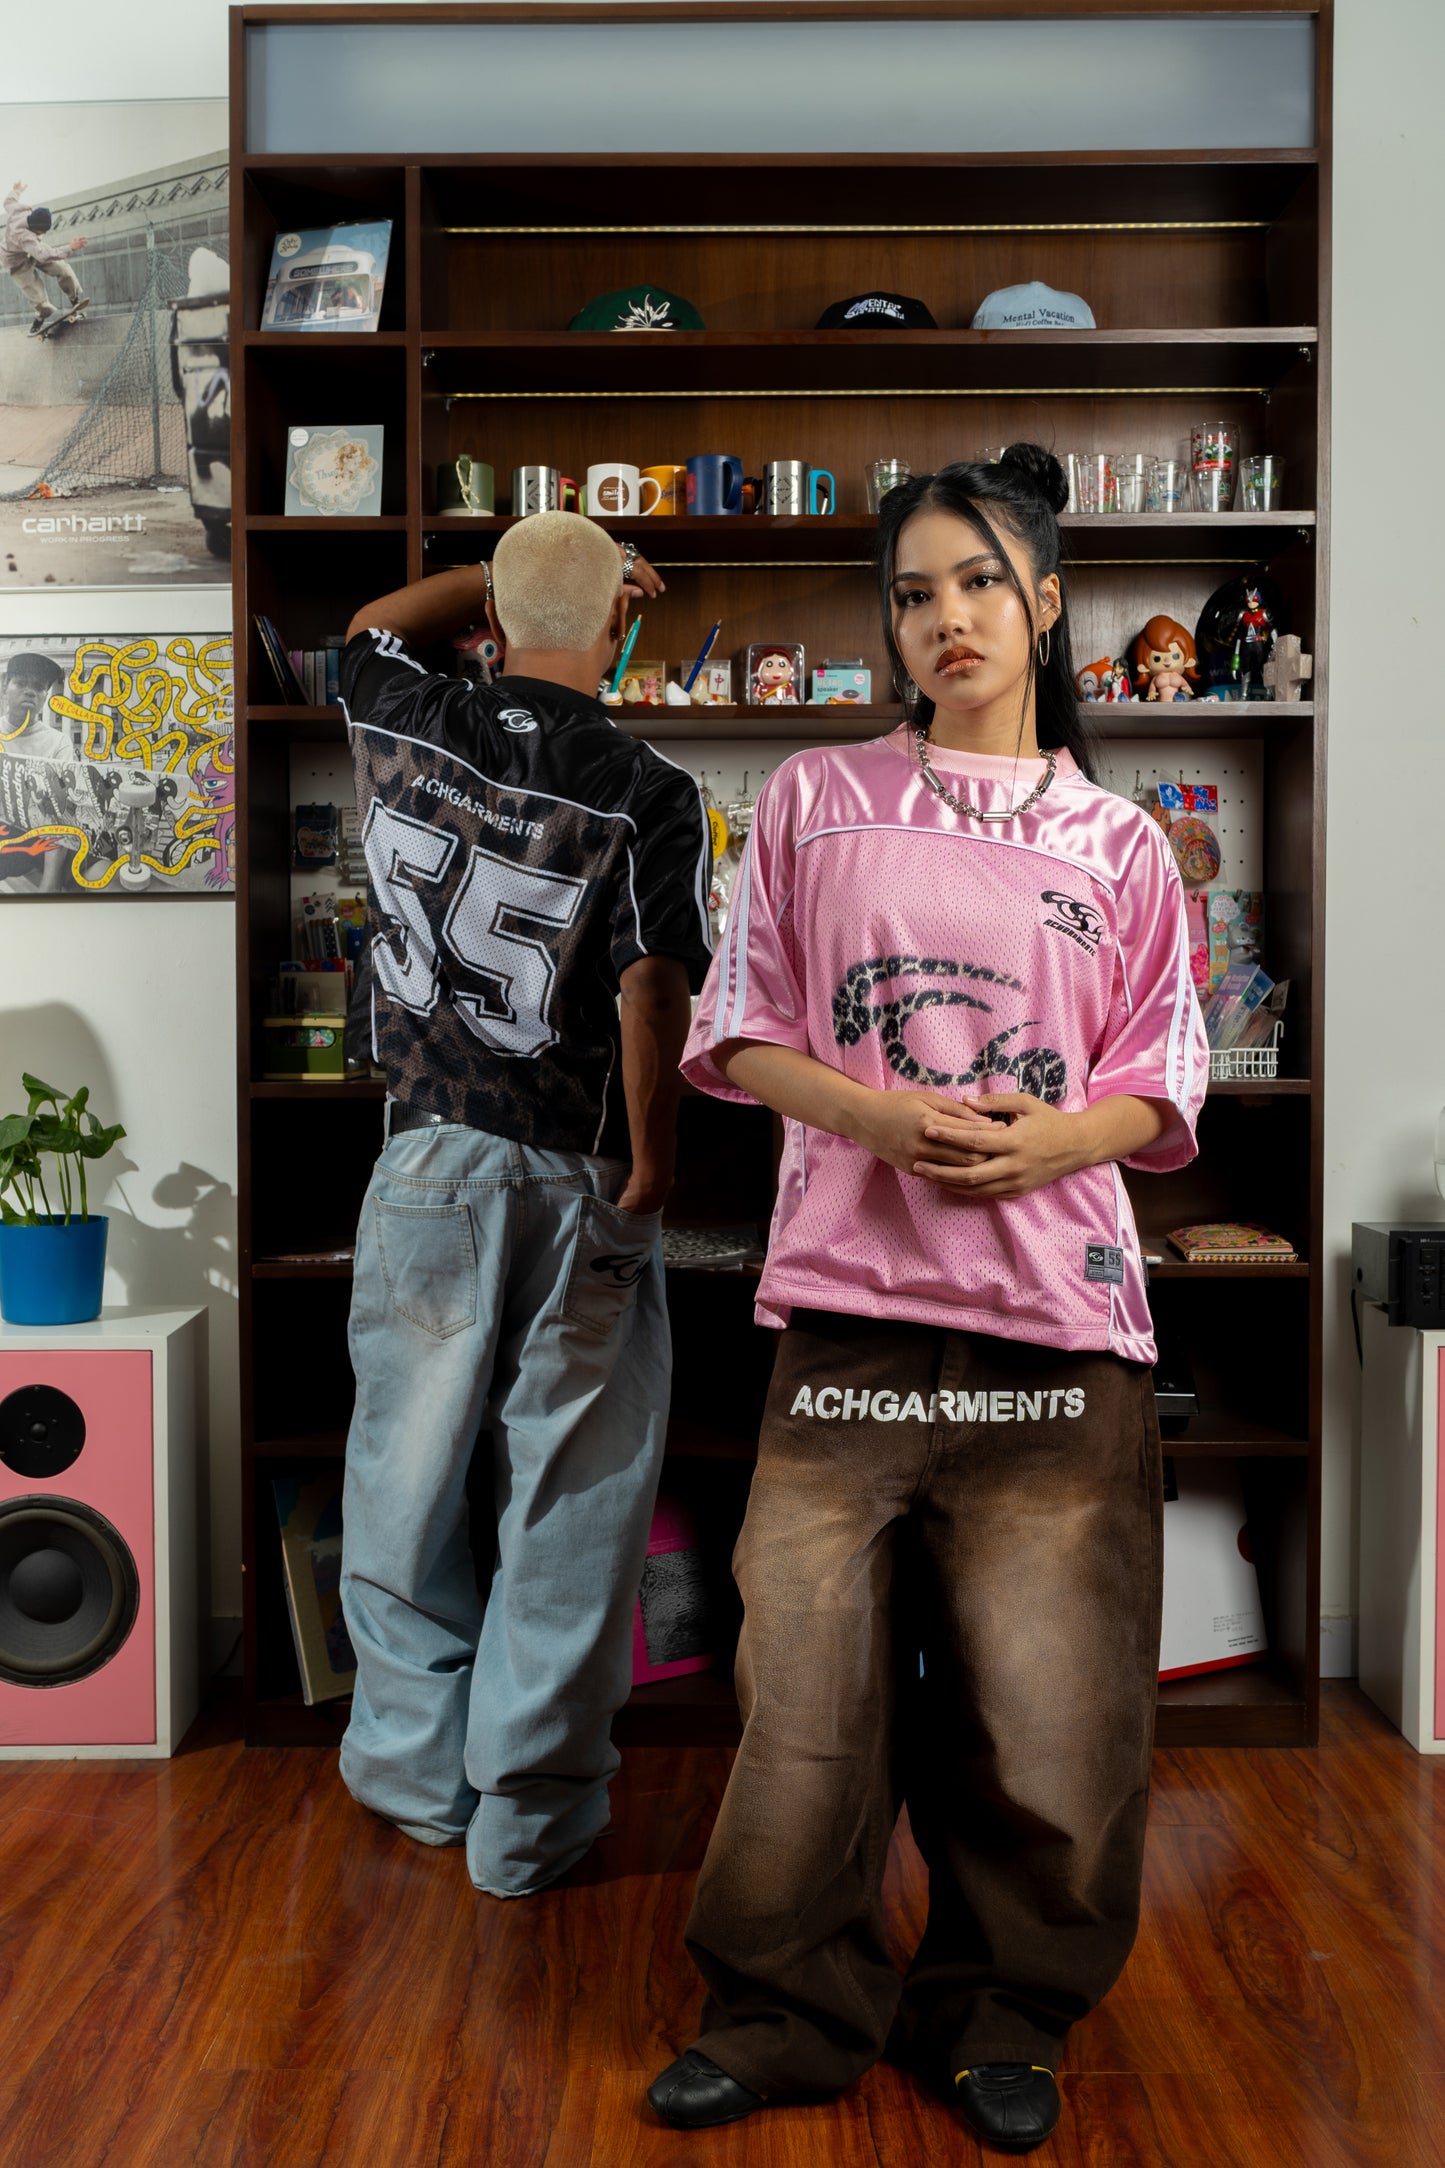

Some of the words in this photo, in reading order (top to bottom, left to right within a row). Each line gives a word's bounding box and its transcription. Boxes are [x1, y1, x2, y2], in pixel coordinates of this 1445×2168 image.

[1002, 311, 1036, 324] Mental
[1039, 308, 1075, 323] Vacation
[22, 513, 147, 533] carhartt
[40, 535, 68, 544] WORK
[68, 535, 79, 543] IN
[79, 535, 130, 543] PROGRESS
[1, 760, 15, 822] Supreme
[12, 761, 28, 828] Supreme
[410, 774, 544, 841] ACHGARMENTS
[362, 796, 588, 1059] 55
[790, 1385, 1086, 1423] ACHGARMENTS
